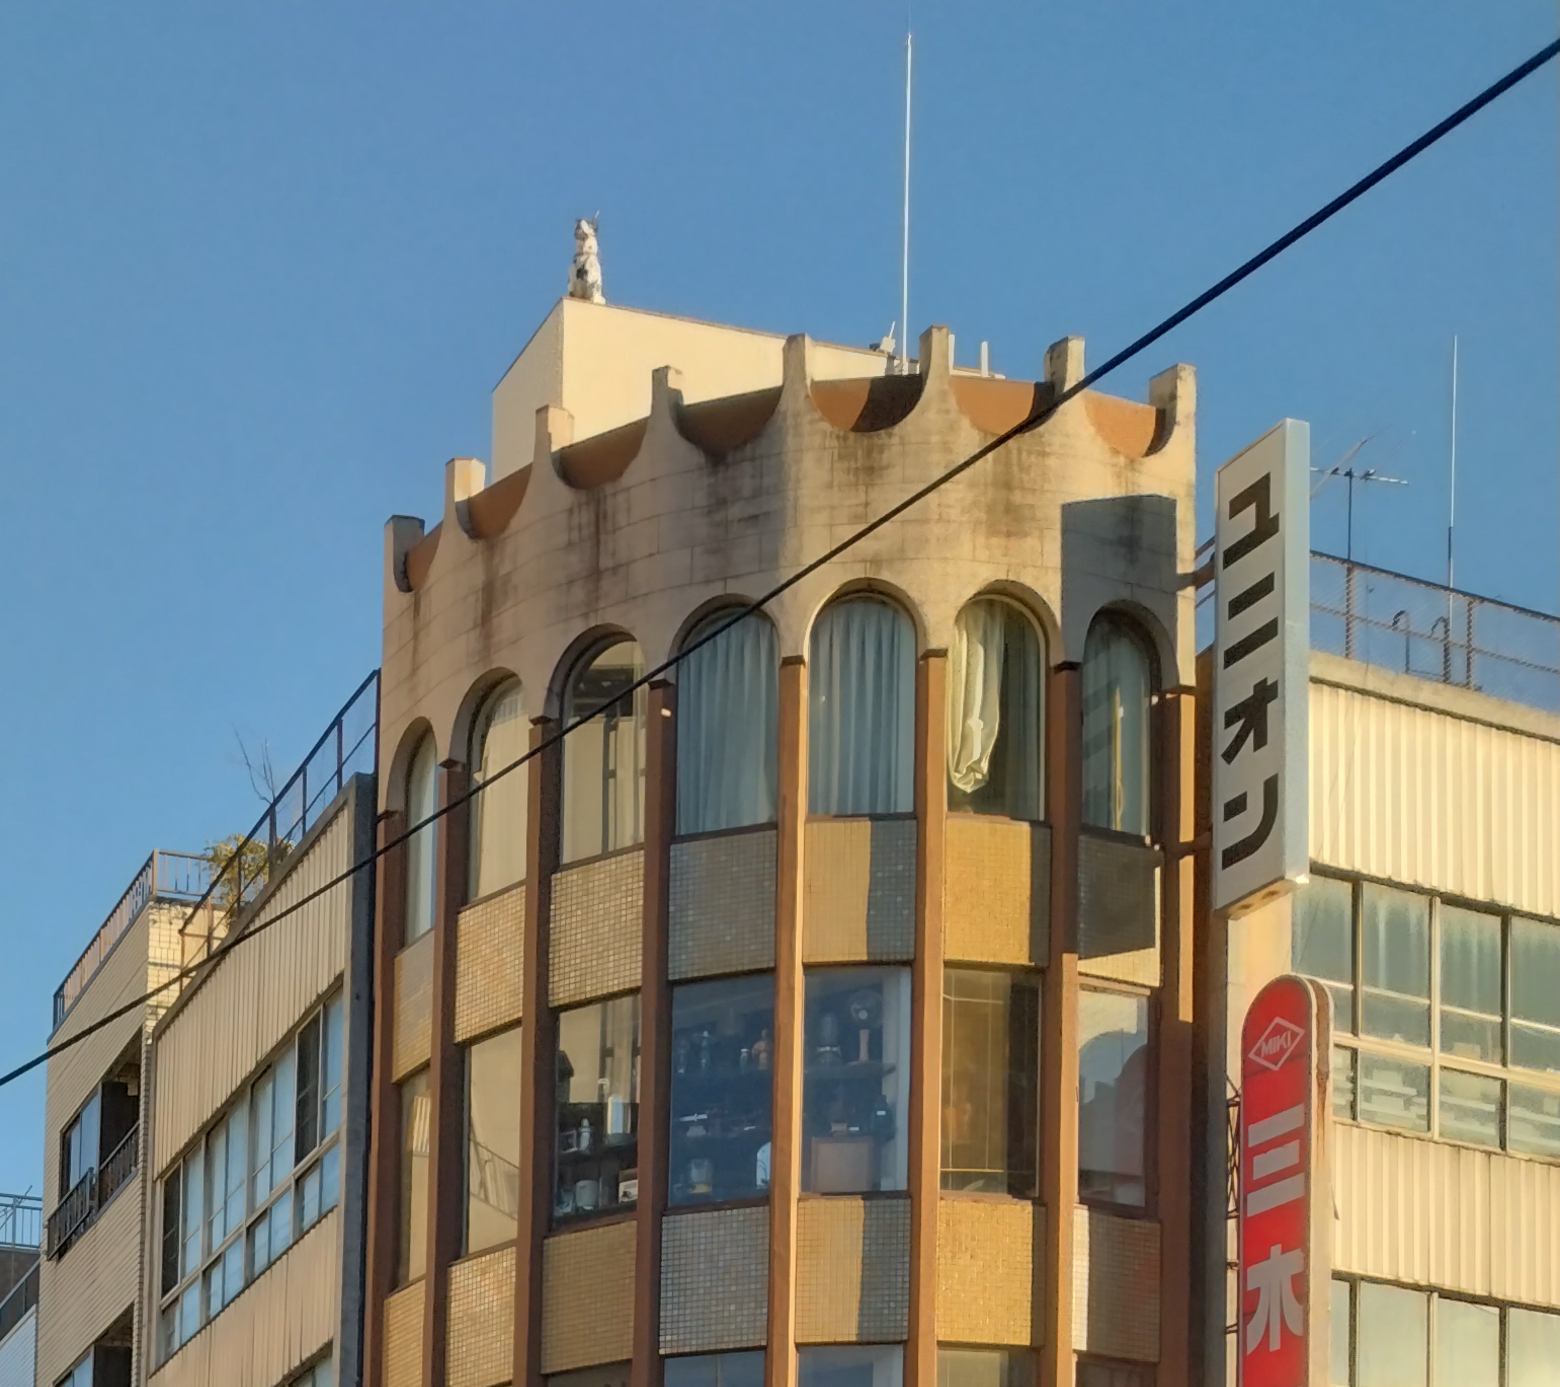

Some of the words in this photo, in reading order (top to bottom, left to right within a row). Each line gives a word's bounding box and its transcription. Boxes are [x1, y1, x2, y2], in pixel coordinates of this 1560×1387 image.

[1221, 471, 1280, 871] ユニオン
[1260, 1030, 1292, 1058] MIKI
